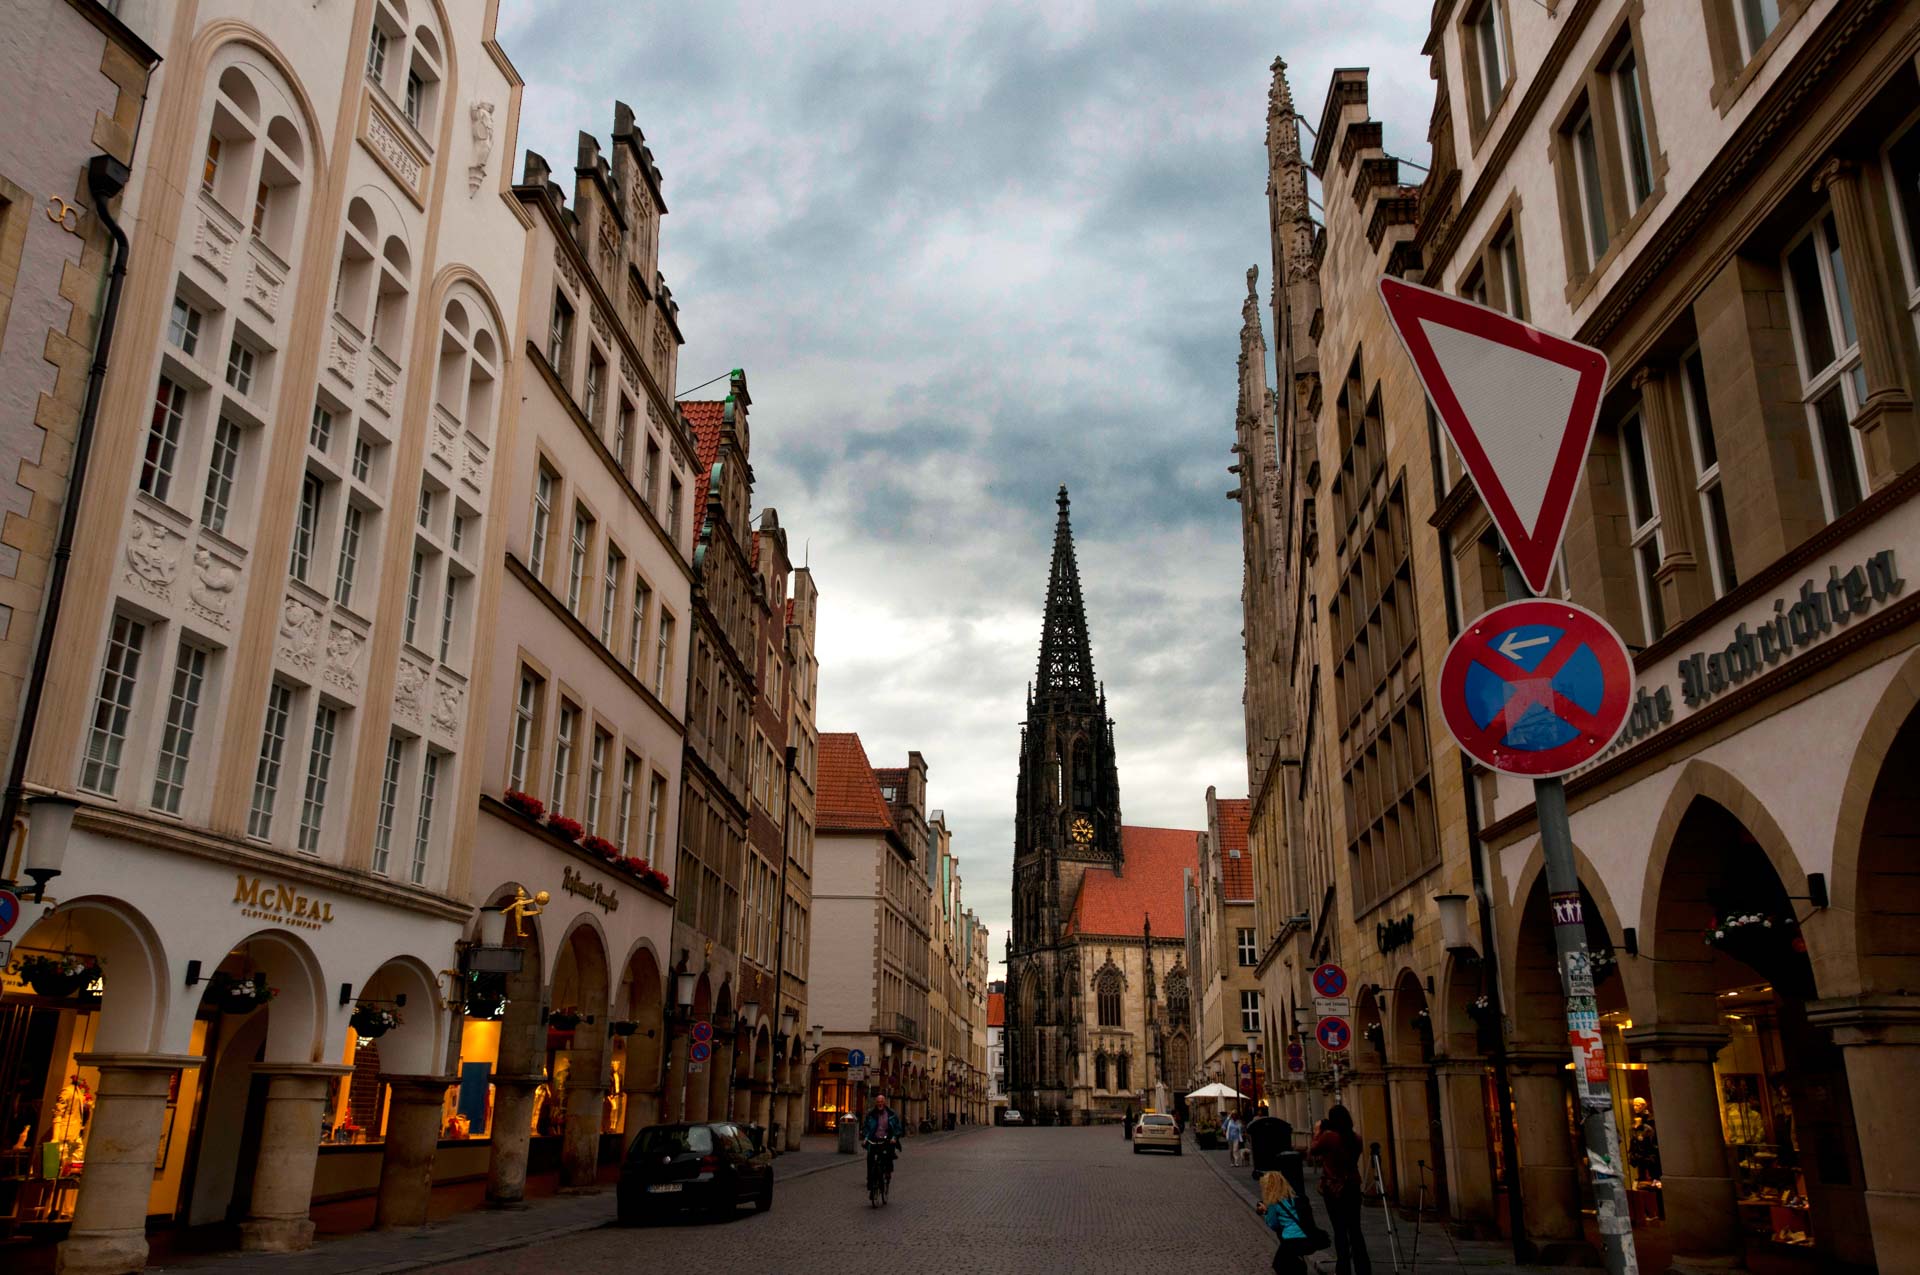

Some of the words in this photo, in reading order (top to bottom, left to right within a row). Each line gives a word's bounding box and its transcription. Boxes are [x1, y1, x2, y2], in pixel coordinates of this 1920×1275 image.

[1678, 549, 1906, 708] Nachrichten
[241, 908, 283, 923] CLOTHING
[286, 917, 322, 931] COMPANY
